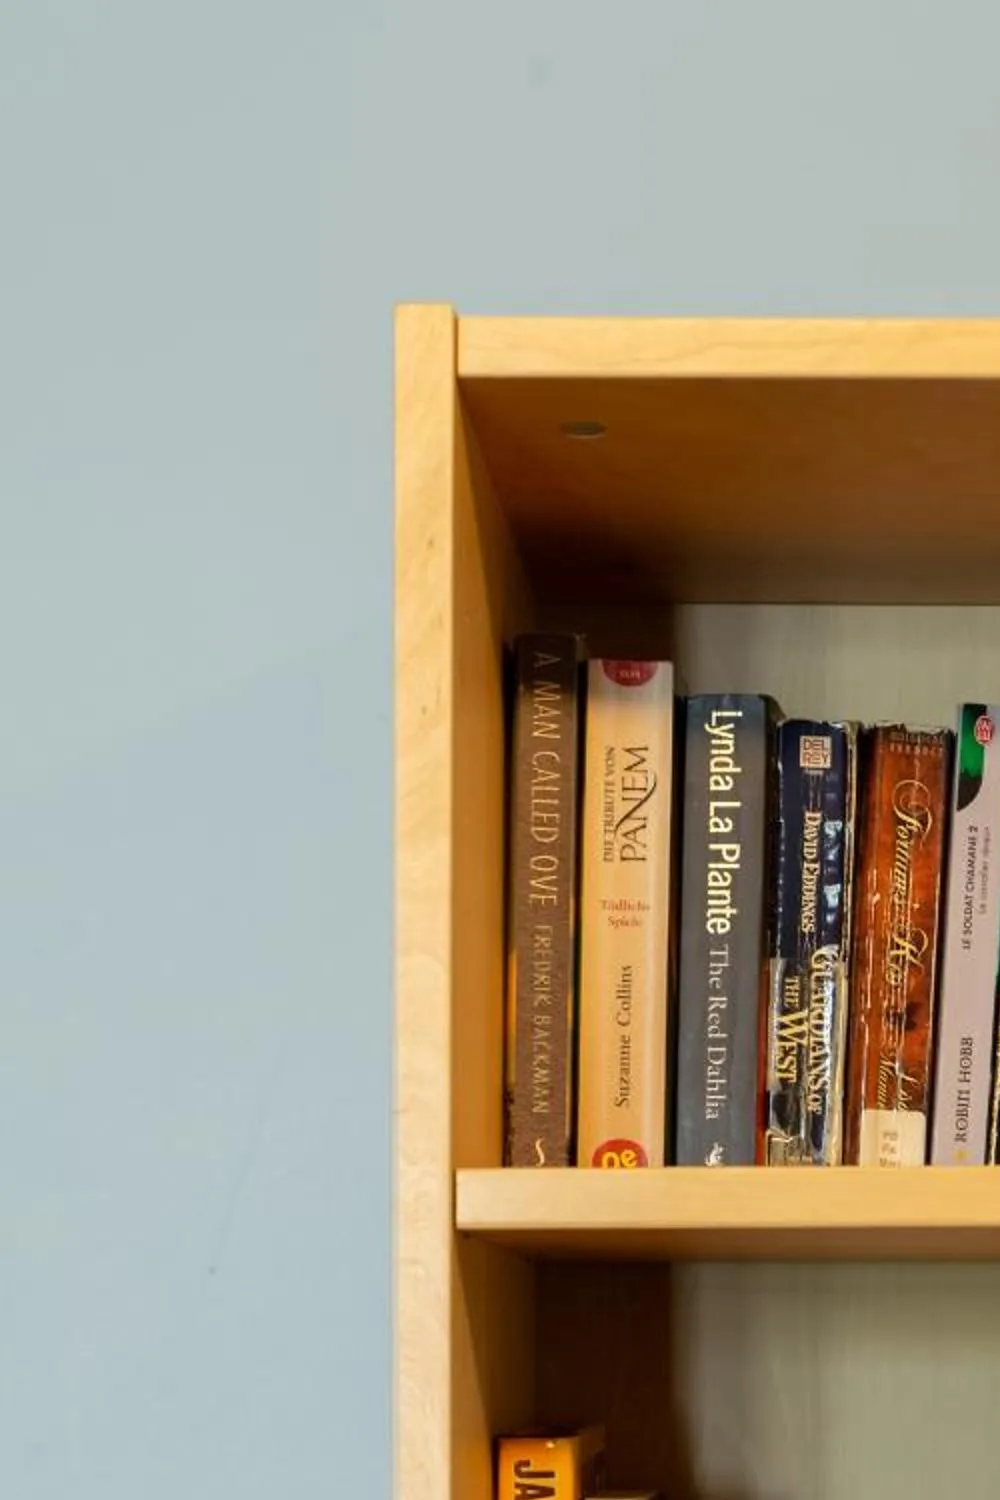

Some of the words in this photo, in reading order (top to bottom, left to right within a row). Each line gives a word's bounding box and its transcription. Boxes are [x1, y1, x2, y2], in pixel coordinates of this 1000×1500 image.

[530, 681, 562, 740] MAN
[705, 710, 743, 790] Lynda
[530, 750, 561, 845] CALLED
[617, 746, 657, 862] PANEM
[709, 801, 742, 833] La
[801, 811, 824, 860] DAVID
[529, 856, 560, 907] OVE
[706, 843, 740, 935] Plante
[798, 862, 822, 934] EDDINGS
[533, 924, 554, 1007] FREDRIK
[614, 965, 632, 1027] Collins
[707, 944, 729, 991] The
[783, 976, 801, 1009] THE
[706, 996, 728, 1039] Red
[775, 1010, 807, 1084] WEST
[530, 1014, 552, 1114] BACKMAN
[615, 1035, 632, 1107] Suzanne
[704, 1045, 728, 1120] Dahlia
